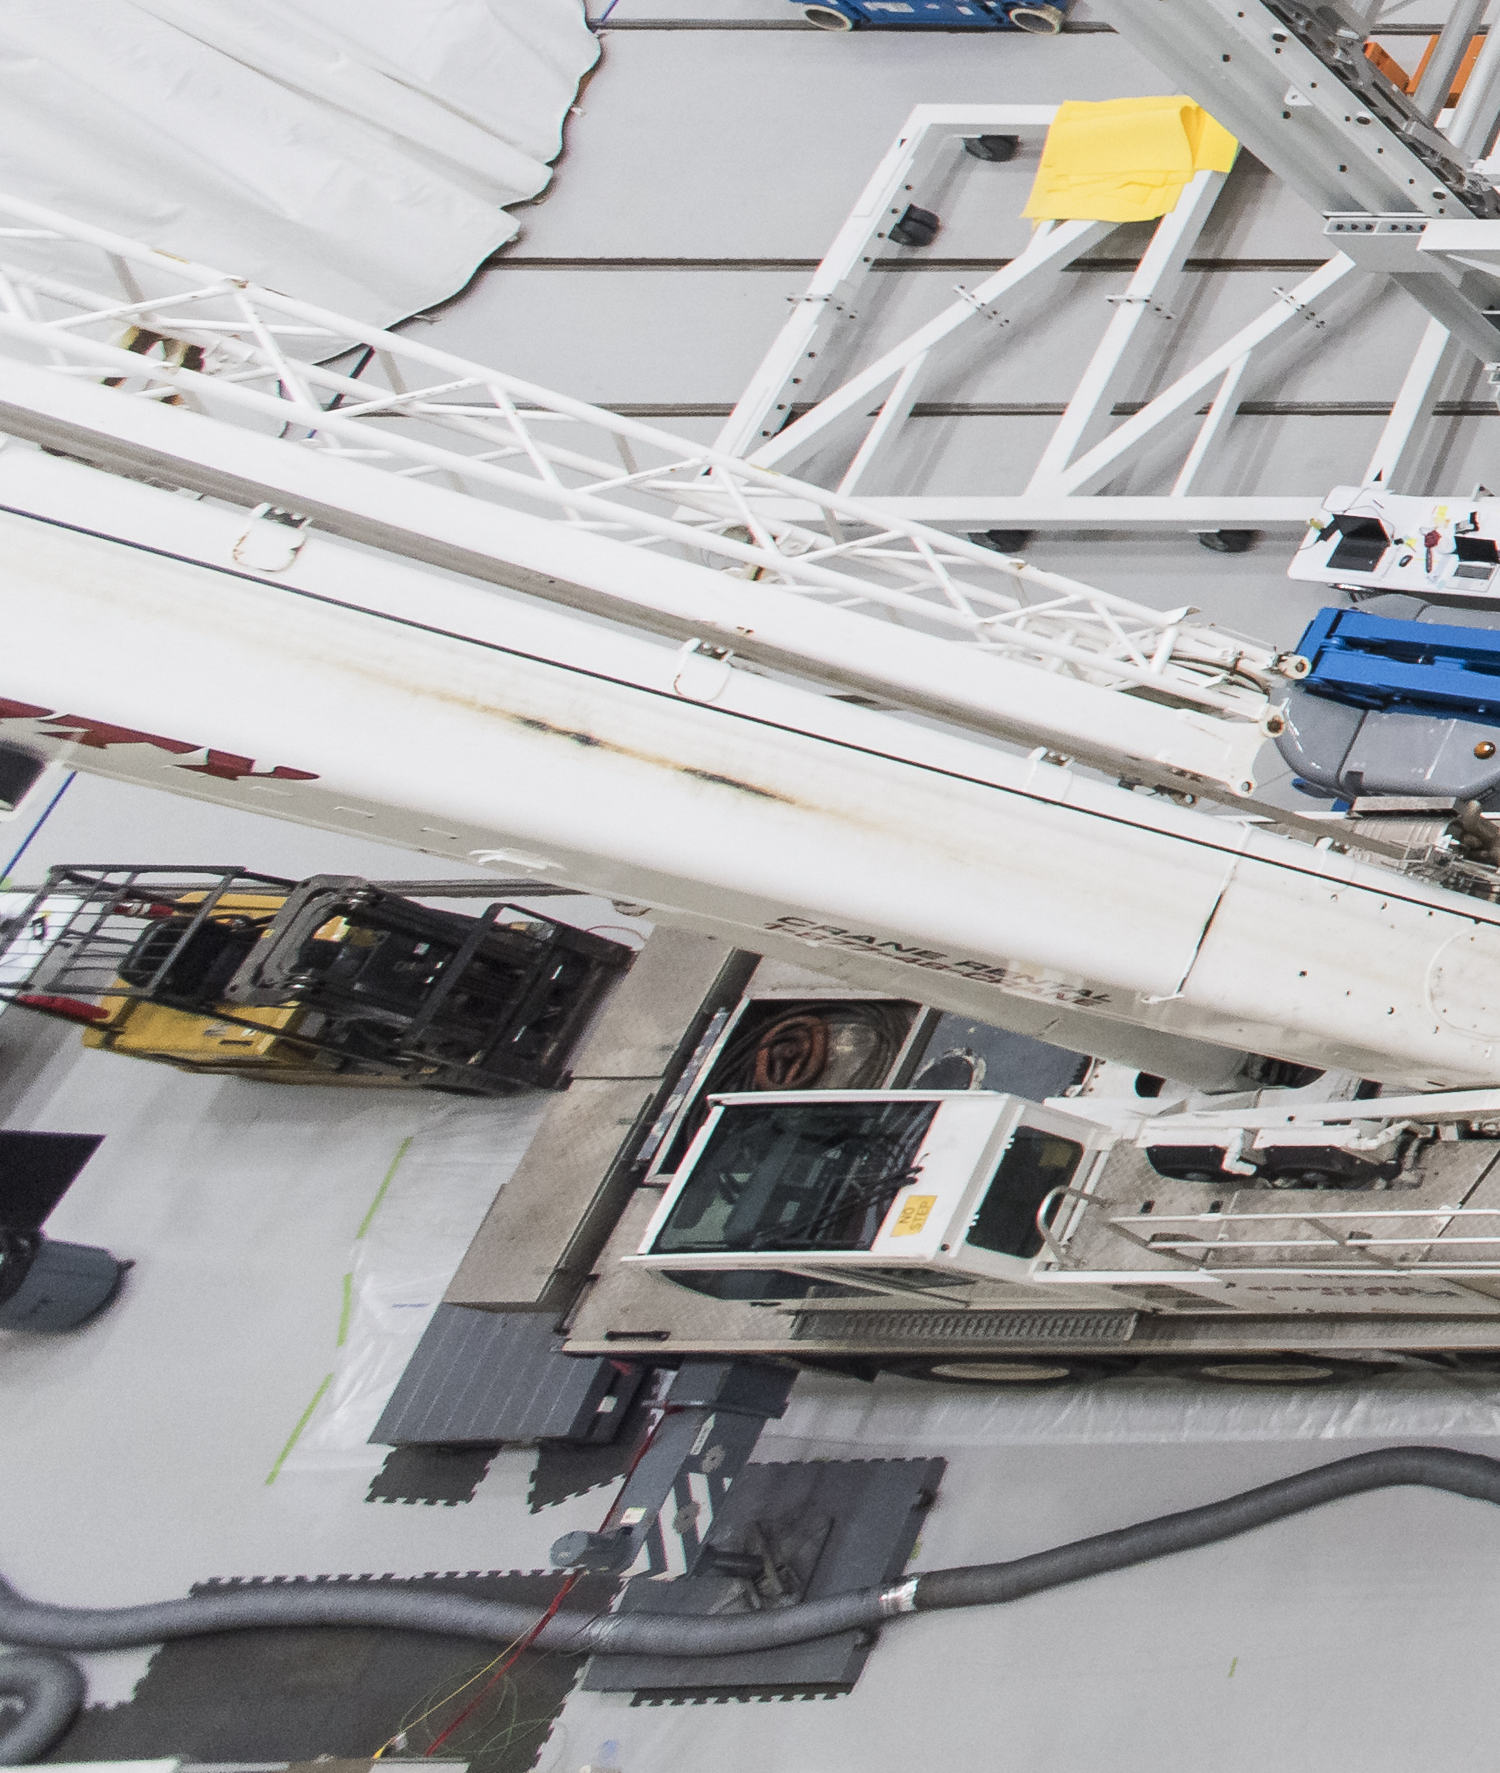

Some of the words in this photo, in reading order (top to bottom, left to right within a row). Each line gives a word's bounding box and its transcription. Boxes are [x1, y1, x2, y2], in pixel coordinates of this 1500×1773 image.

[777, 917, 947, 959] CRANE
[899, 1207, 914, 1224] NO
[910, 1200, 928, 1230] STEP
